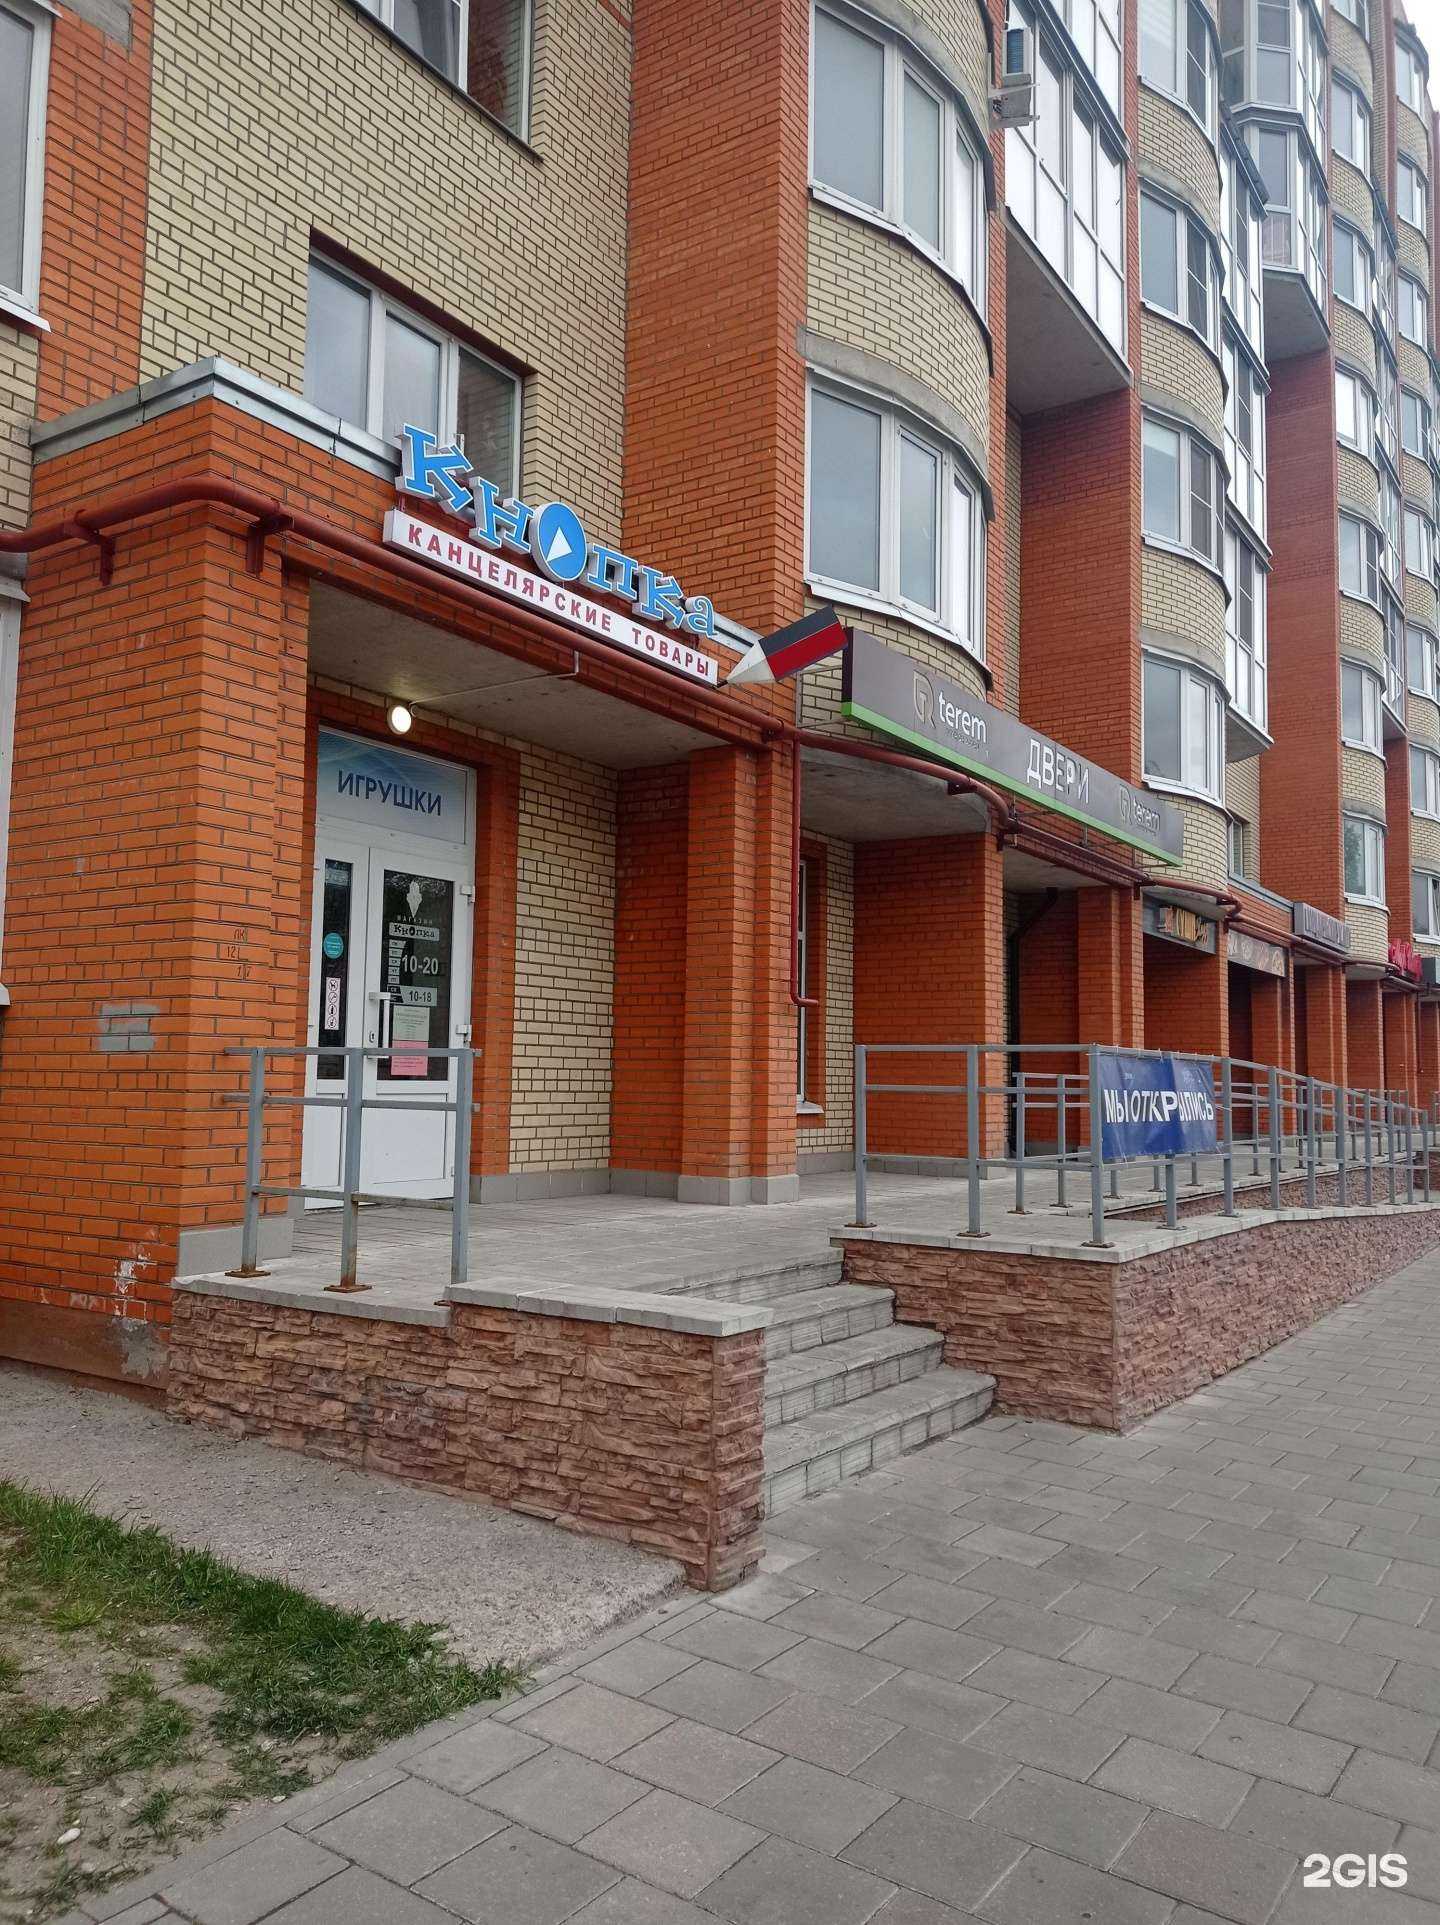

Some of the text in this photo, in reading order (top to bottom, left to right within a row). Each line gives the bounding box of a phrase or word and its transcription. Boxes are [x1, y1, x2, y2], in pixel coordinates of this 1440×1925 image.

[408, 523, 710, 677] КАНЦЕЛЯРСКИЕ ТОВАРЫ
[938, 690, 987, 744] terem
[337, 769, 442, 817] ИГРУШКИ
[1026, 737, 1089, 805] ДВЕРИ
[401, 954, 439, 975] 10-20
[408, 989, 433, 1003] 10-18
[1103, 1088, 1130, 1124] МЫ
